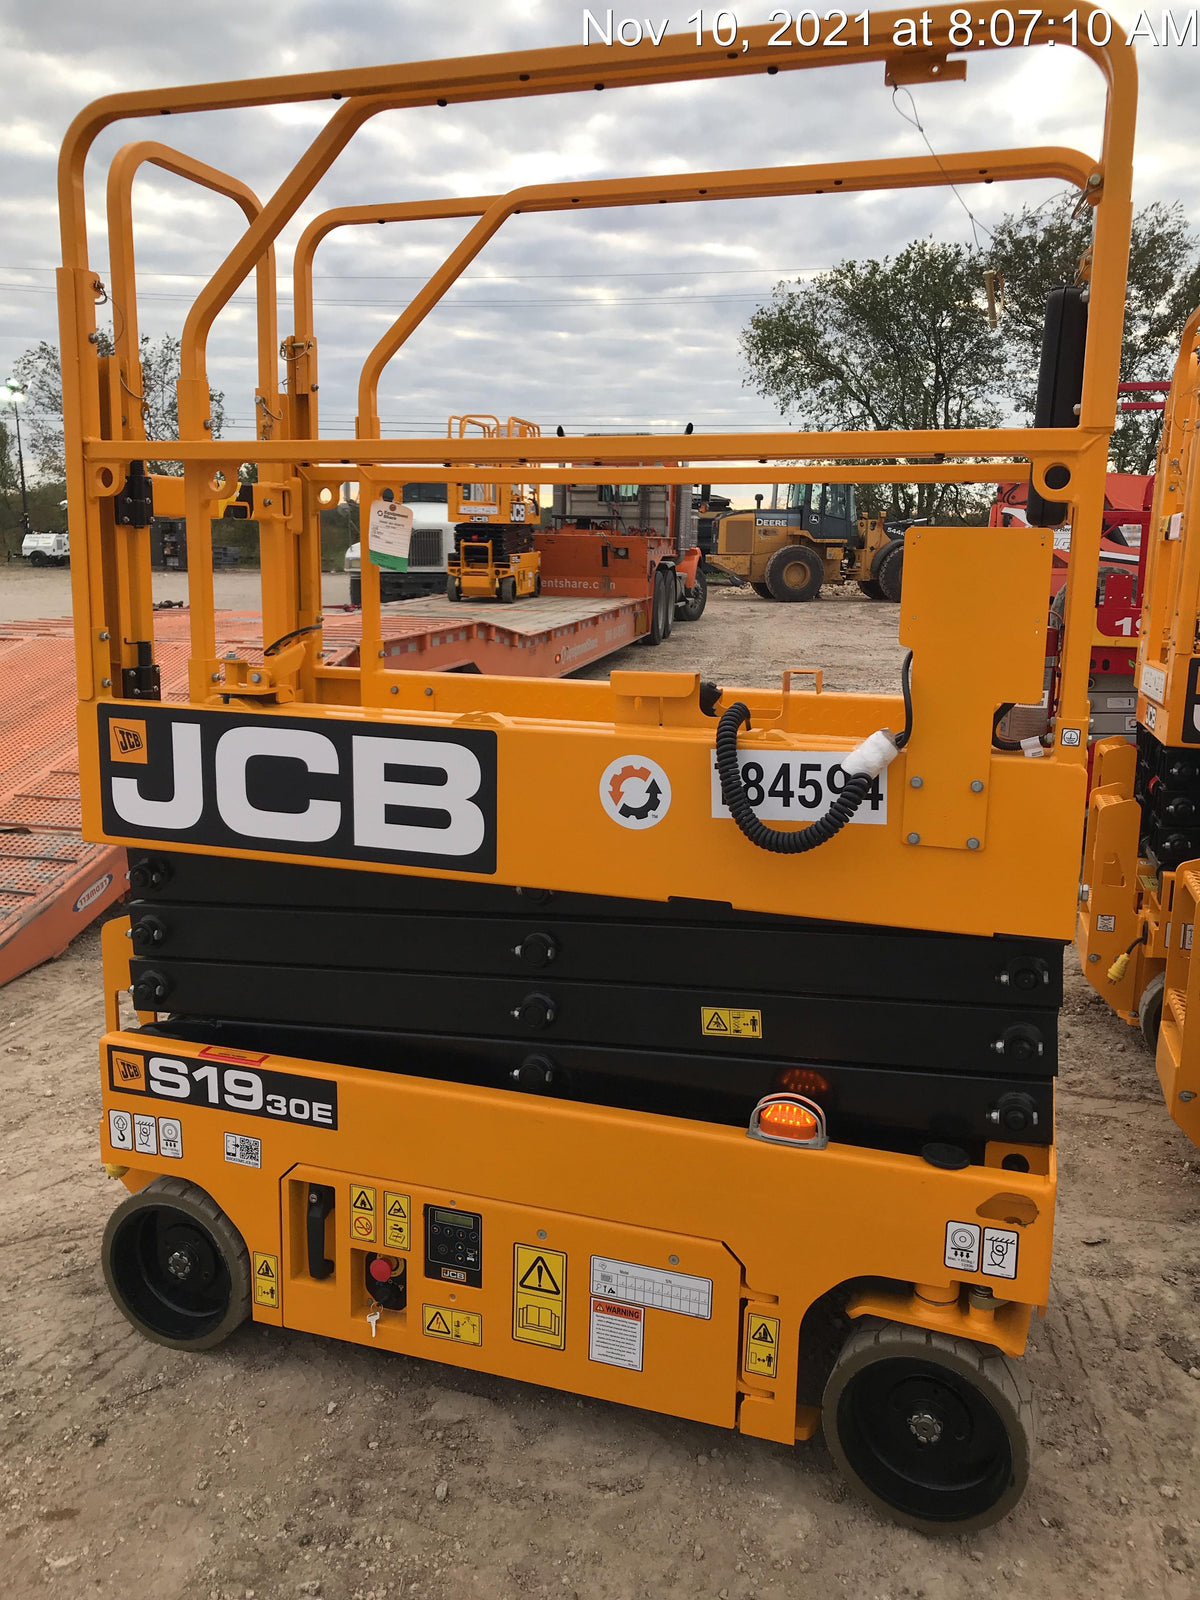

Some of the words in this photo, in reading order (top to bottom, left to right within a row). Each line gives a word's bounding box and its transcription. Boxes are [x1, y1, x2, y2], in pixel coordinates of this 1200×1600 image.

[510, 503, 525, 522] JCB
[756, 518, 788, 527] DEERE
[119, 731, 141, 750] JCB
[111, 721, 485, 856] JCB
[79, 879, 108, 906] LEDWELL
[120, 1061, 141, 1079] JCB
[443, 1270, 465, 1280] JCB
[605, 1304, 640, 1319] WARNING
